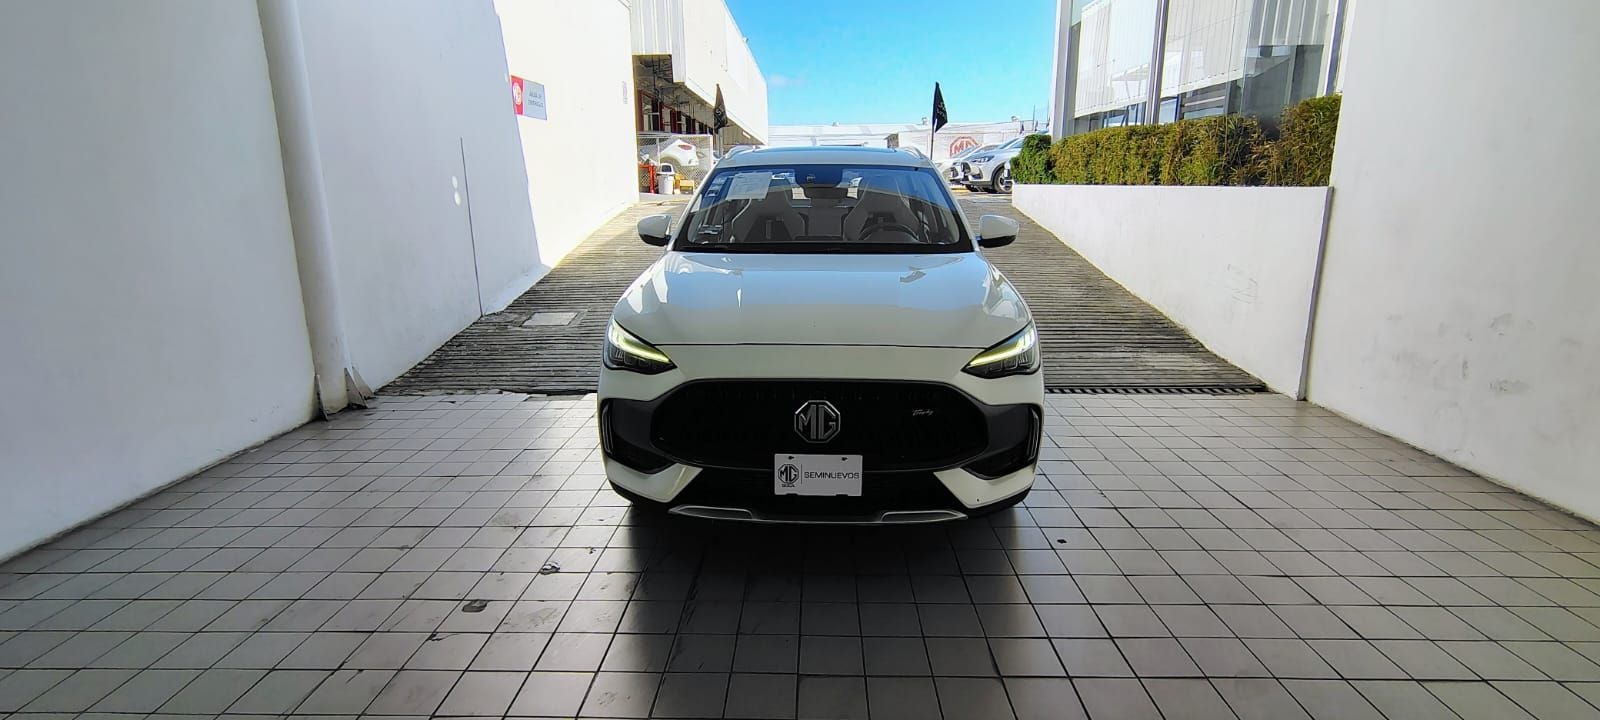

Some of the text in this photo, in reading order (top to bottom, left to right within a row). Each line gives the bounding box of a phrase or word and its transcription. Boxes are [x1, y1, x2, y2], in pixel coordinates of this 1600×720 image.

[798, 404, 837, 440] MG
[779, 465, 860, 482] MG SEMINUEVOS
